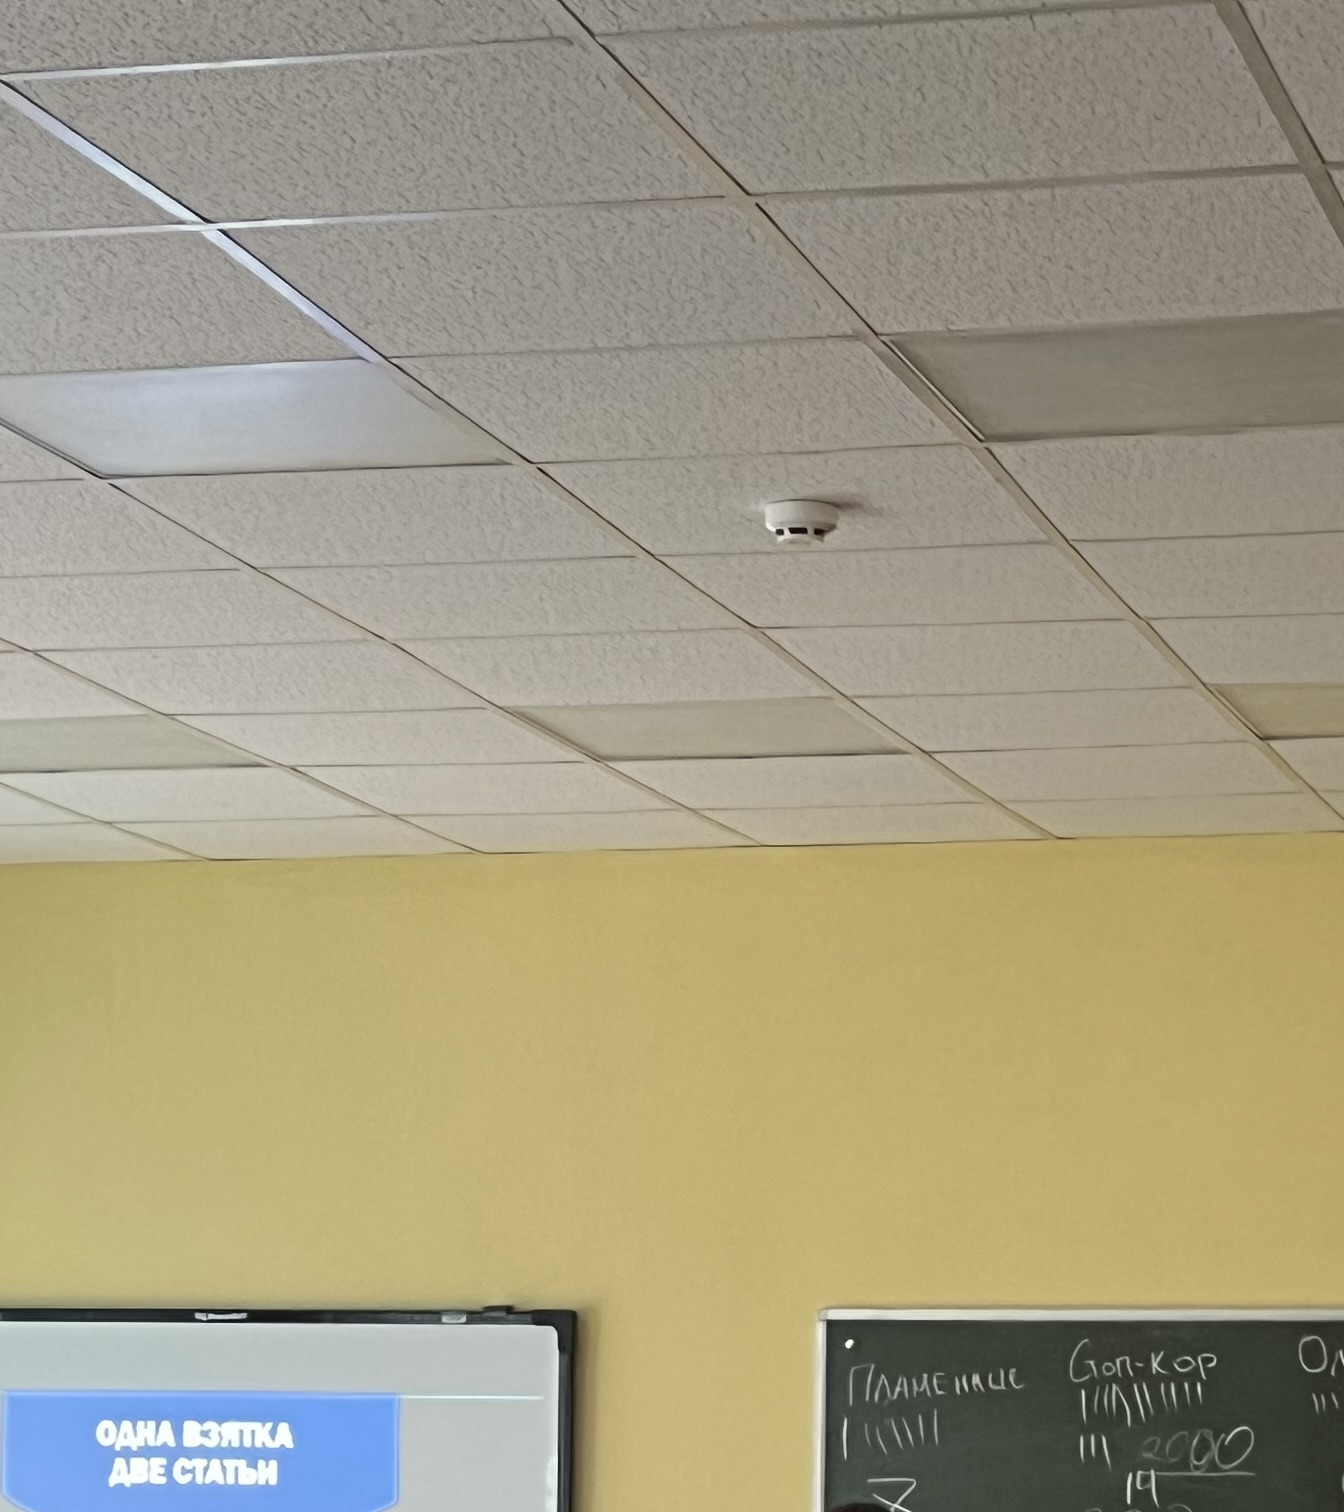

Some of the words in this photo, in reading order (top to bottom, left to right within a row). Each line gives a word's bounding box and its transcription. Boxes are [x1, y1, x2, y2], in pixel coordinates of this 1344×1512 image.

[95, 1419, 176, 1451] ОДНА
[182, 1420, 294, 1449] ВЗЯТКА
[108, 1457, 168, 1488] ДВЕ
[172, 1457, 278, 1486] СТАТЬИ
